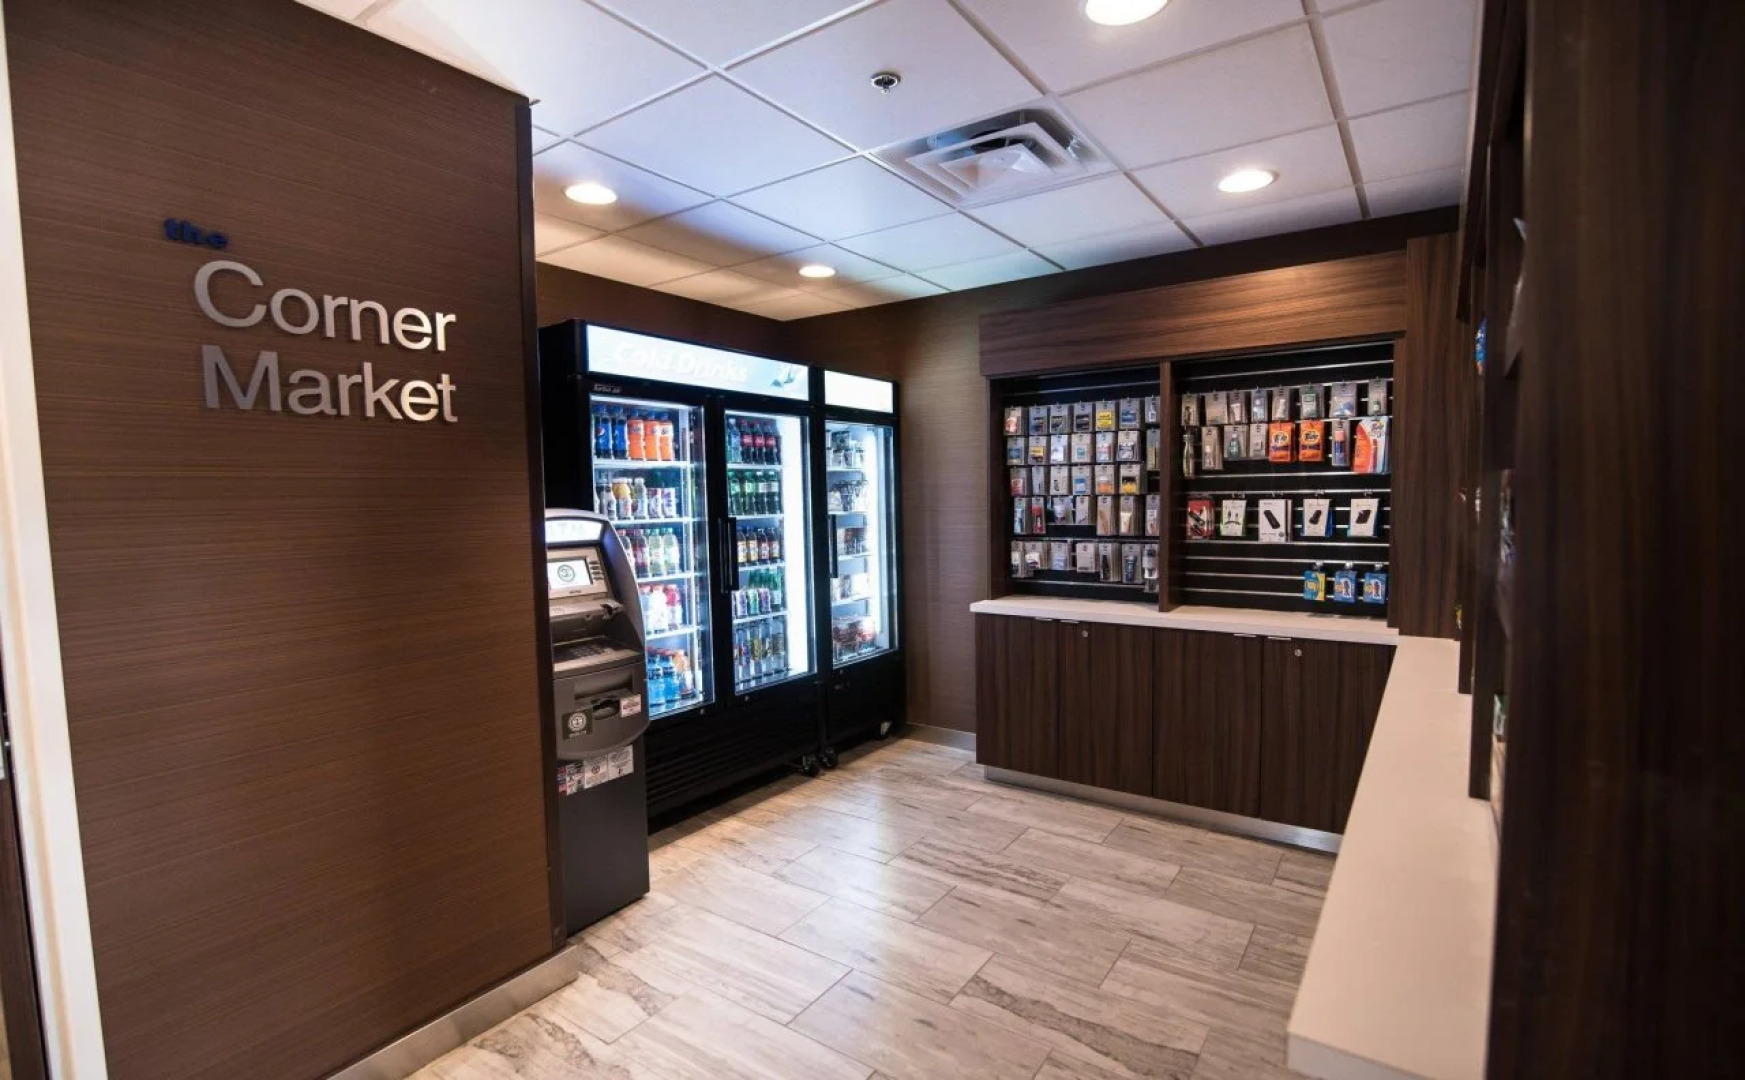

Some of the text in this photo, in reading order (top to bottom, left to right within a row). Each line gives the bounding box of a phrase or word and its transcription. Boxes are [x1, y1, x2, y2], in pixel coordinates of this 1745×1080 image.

[164, 218, 229, 249] the
[194, 260, 456, 351] Corner
[202, 344, 458, 422] Market
[615, 343, 748, 382] Cold Drinks
